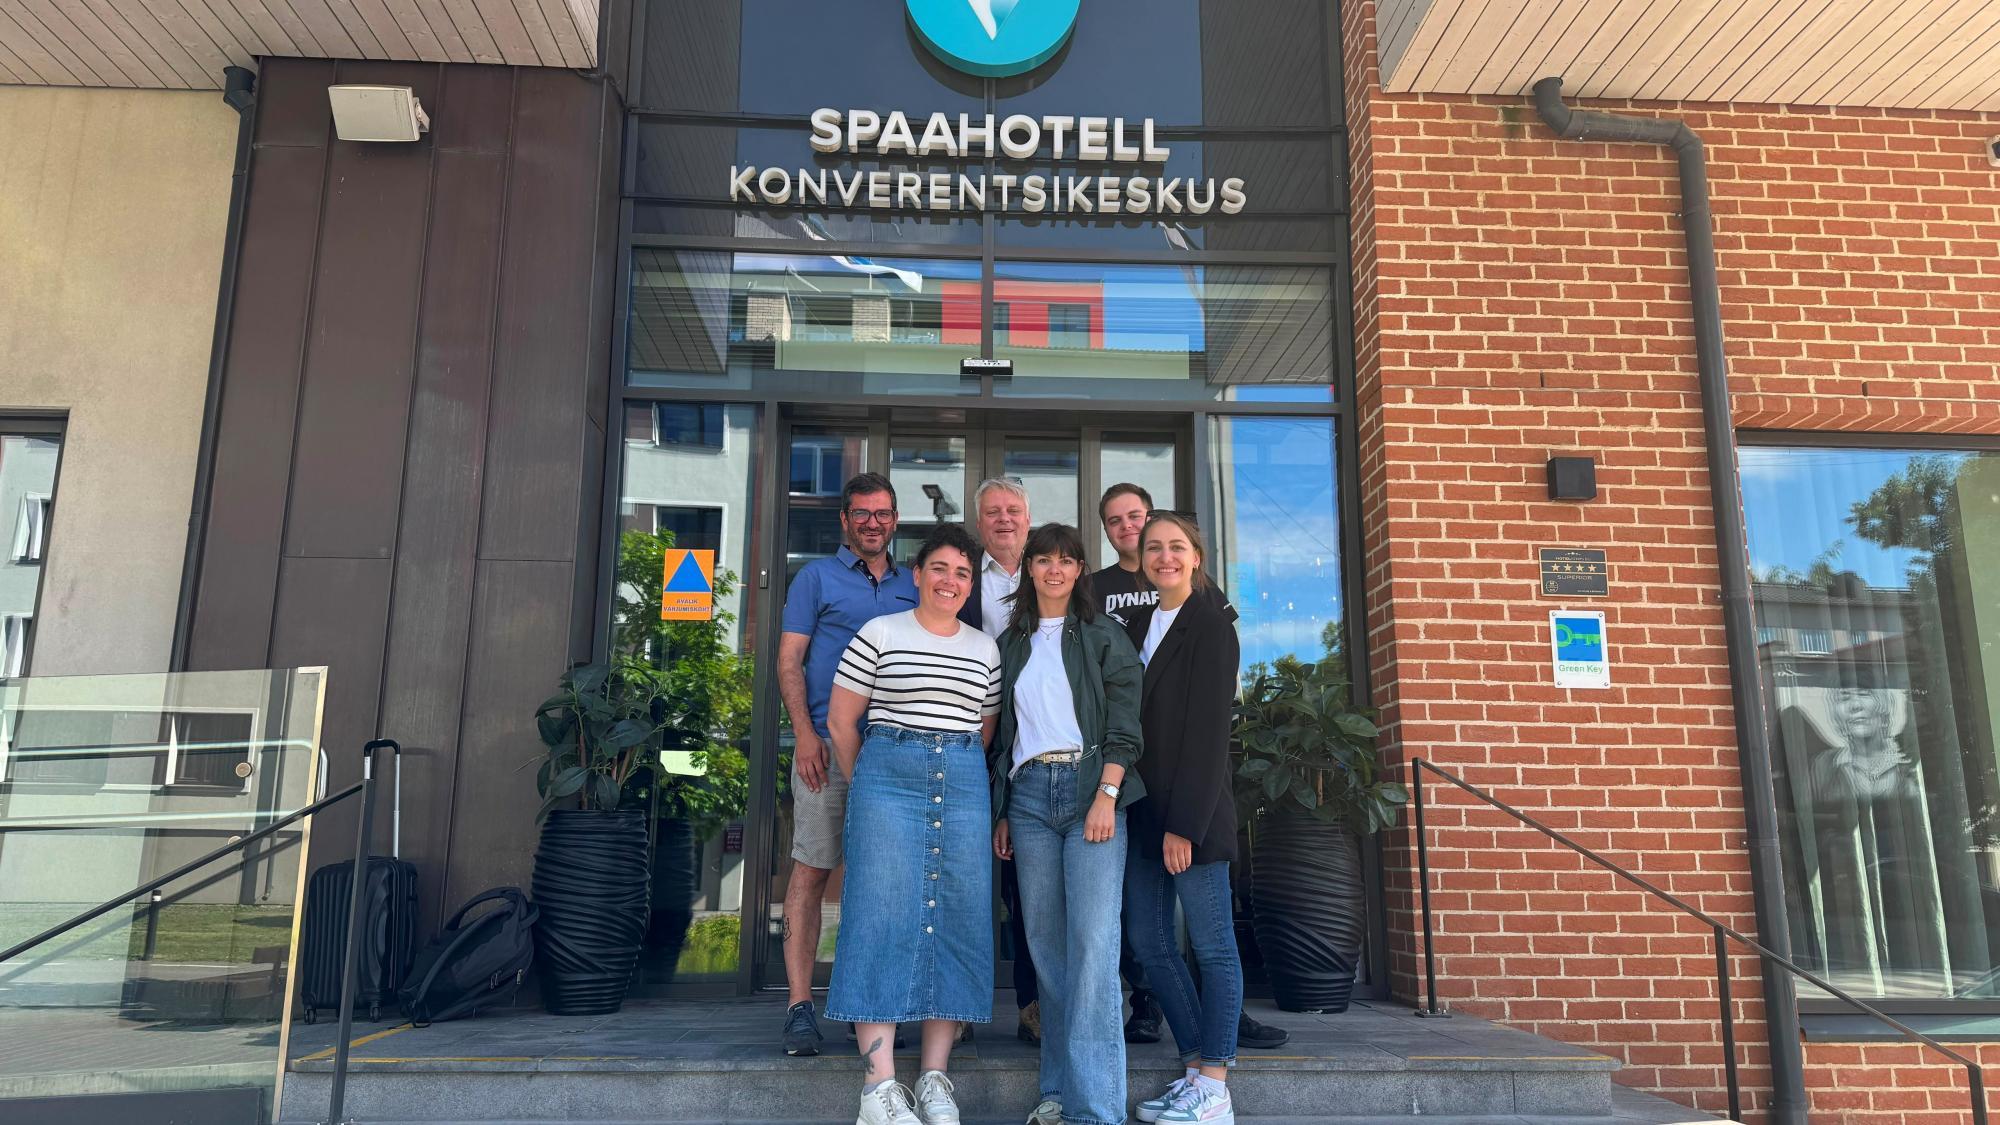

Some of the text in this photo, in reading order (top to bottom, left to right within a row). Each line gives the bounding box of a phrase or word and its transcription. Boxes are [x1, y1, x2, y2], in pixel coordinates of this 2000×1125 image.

[810, 107, 1170, 164] SPAAHOTELL
[729, 165, 1247, 216] KONVERENTSIKESKUS
[1558, 664, 1603, 675] Green Key
